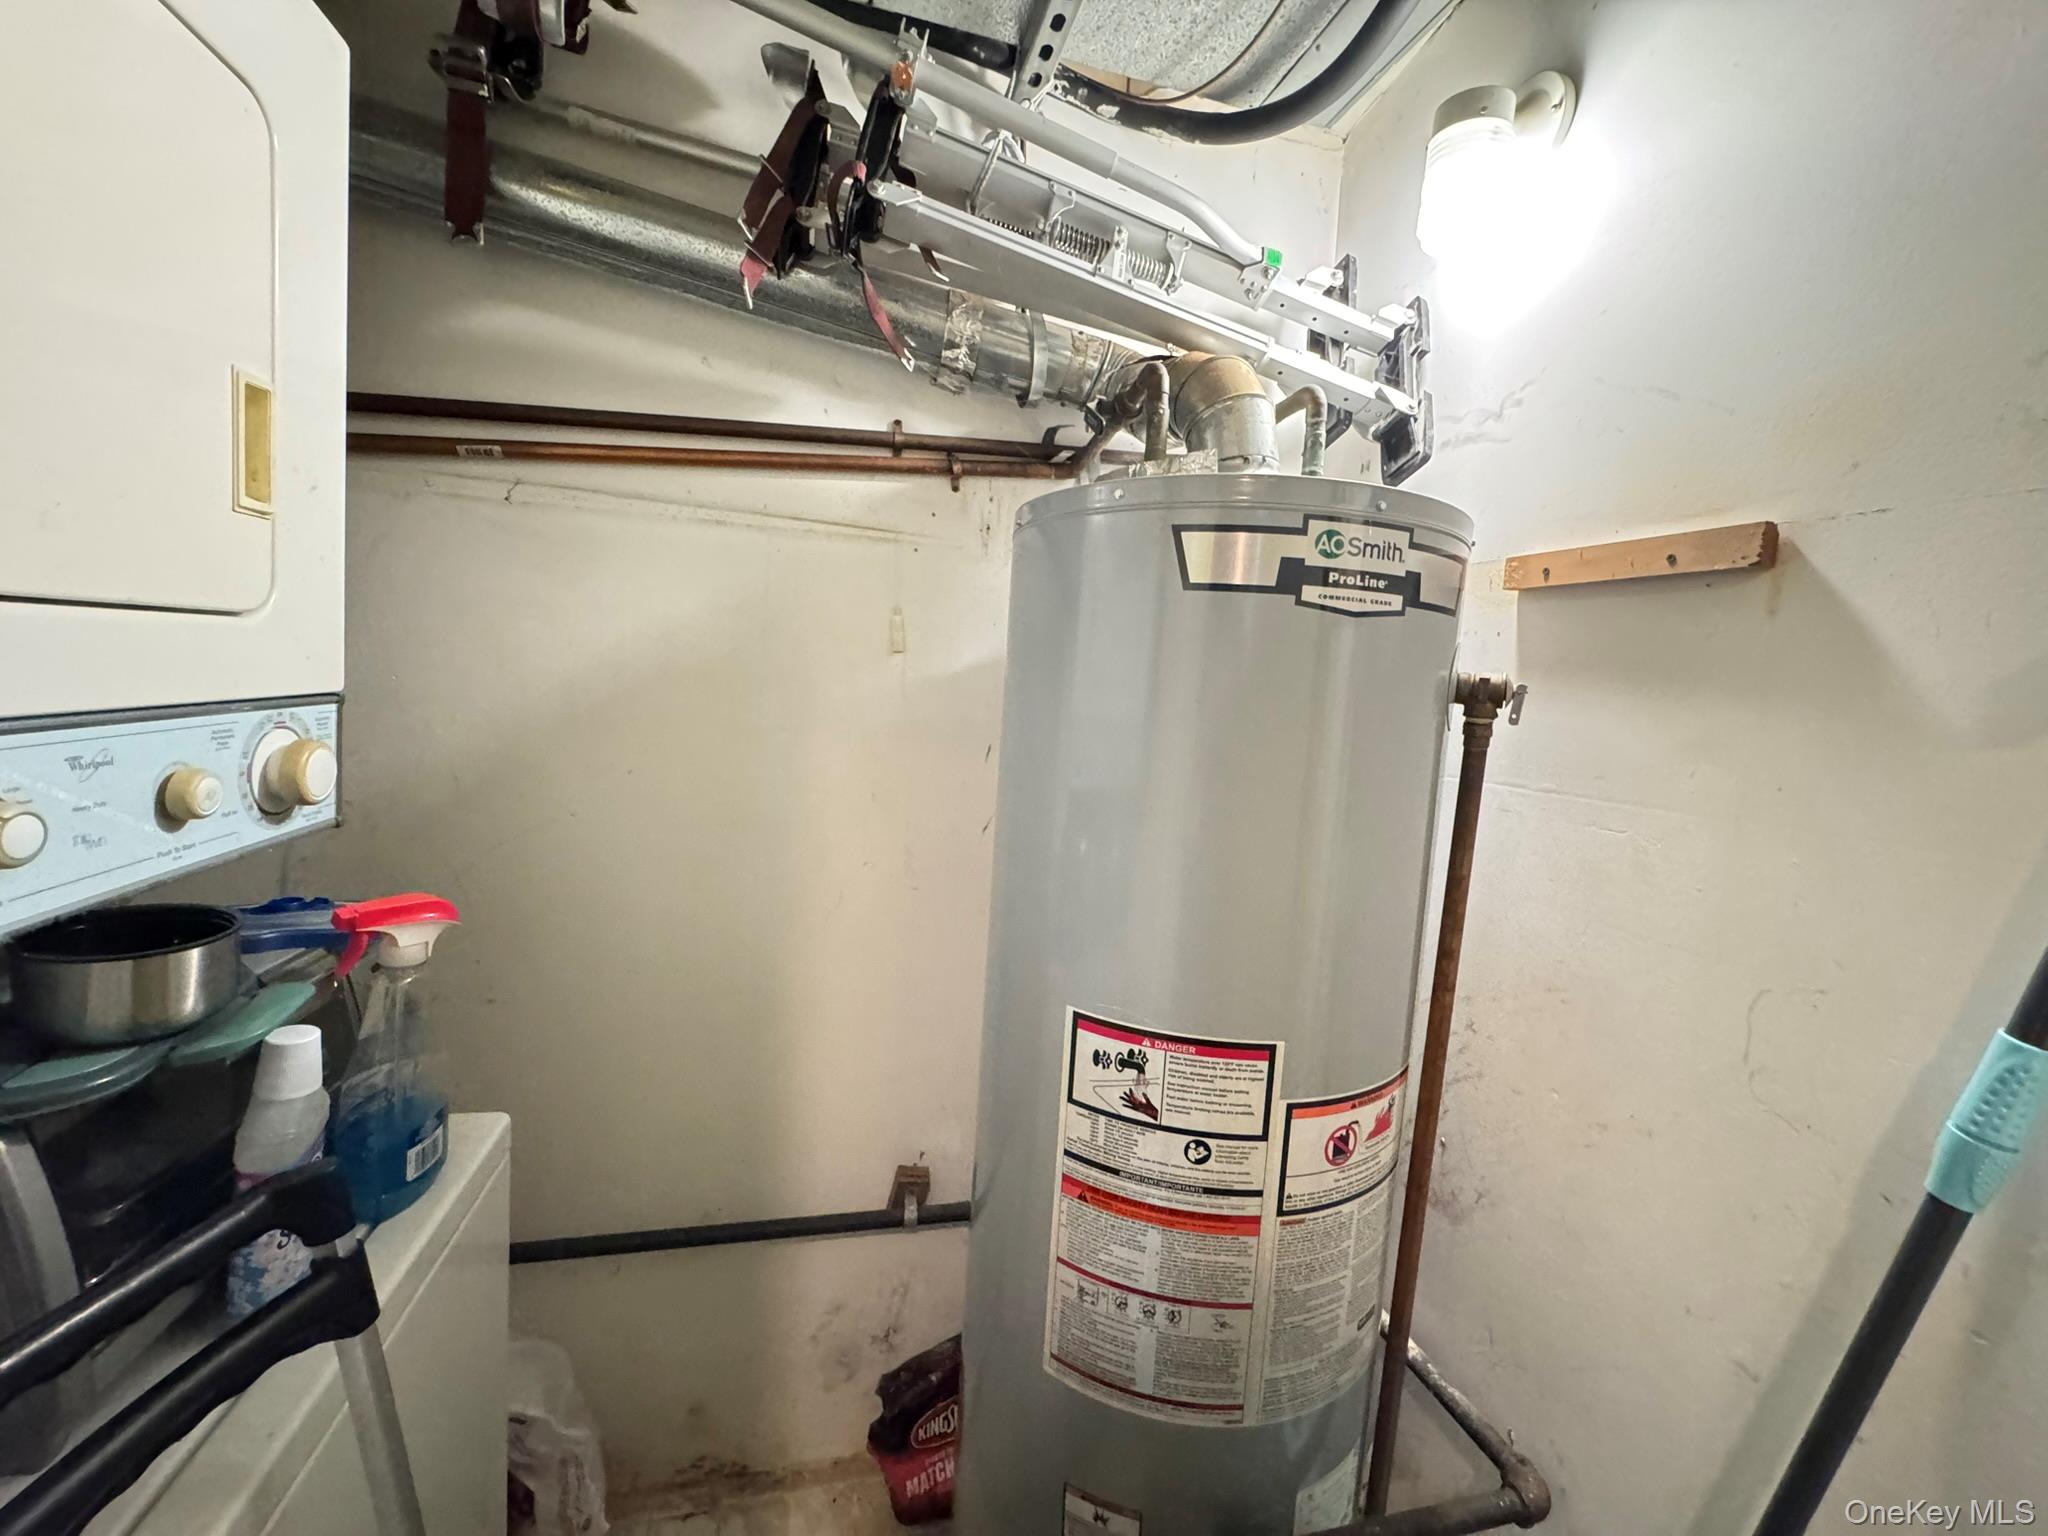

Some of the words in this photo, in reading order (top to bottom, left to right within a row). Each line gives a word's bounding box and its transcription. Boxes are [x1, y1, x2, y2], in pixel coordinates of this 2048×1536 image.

[1318, 593, 1367, 604] COMMERCIAL
[1370, 598, 1392, 607] GRADE
[64, 754, 115, 773] Whirlpool
[1154, 1039, 1197, 1055] DANGER
